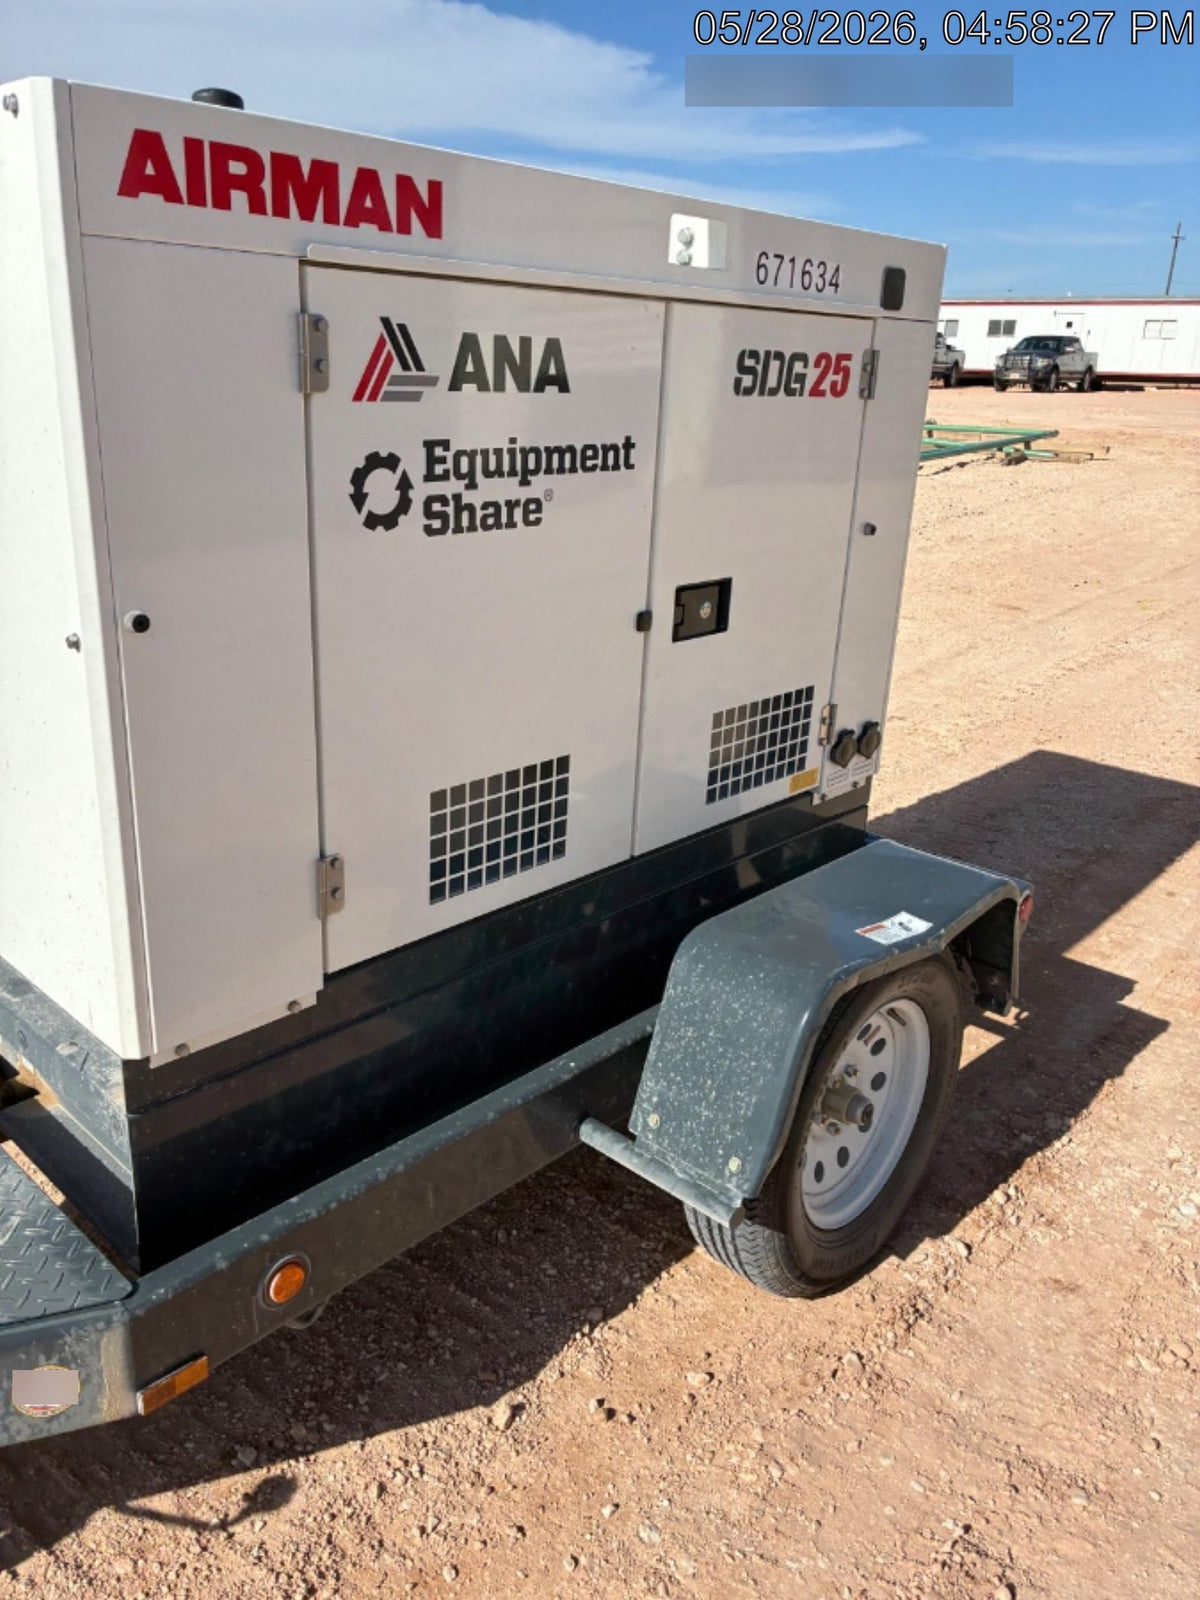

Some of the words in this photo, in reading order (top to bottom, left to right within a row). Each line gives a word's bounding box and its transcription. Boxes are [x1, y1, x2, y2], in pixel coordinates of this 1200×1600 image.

[117, 128, 443, 240] AIRMAN
[756, 251, 841, 294] 671634
[447, 332, 571, 393] ANA
[733, 349, 853, 398] SDG25
[422, 435, 636, 490] Equipment
